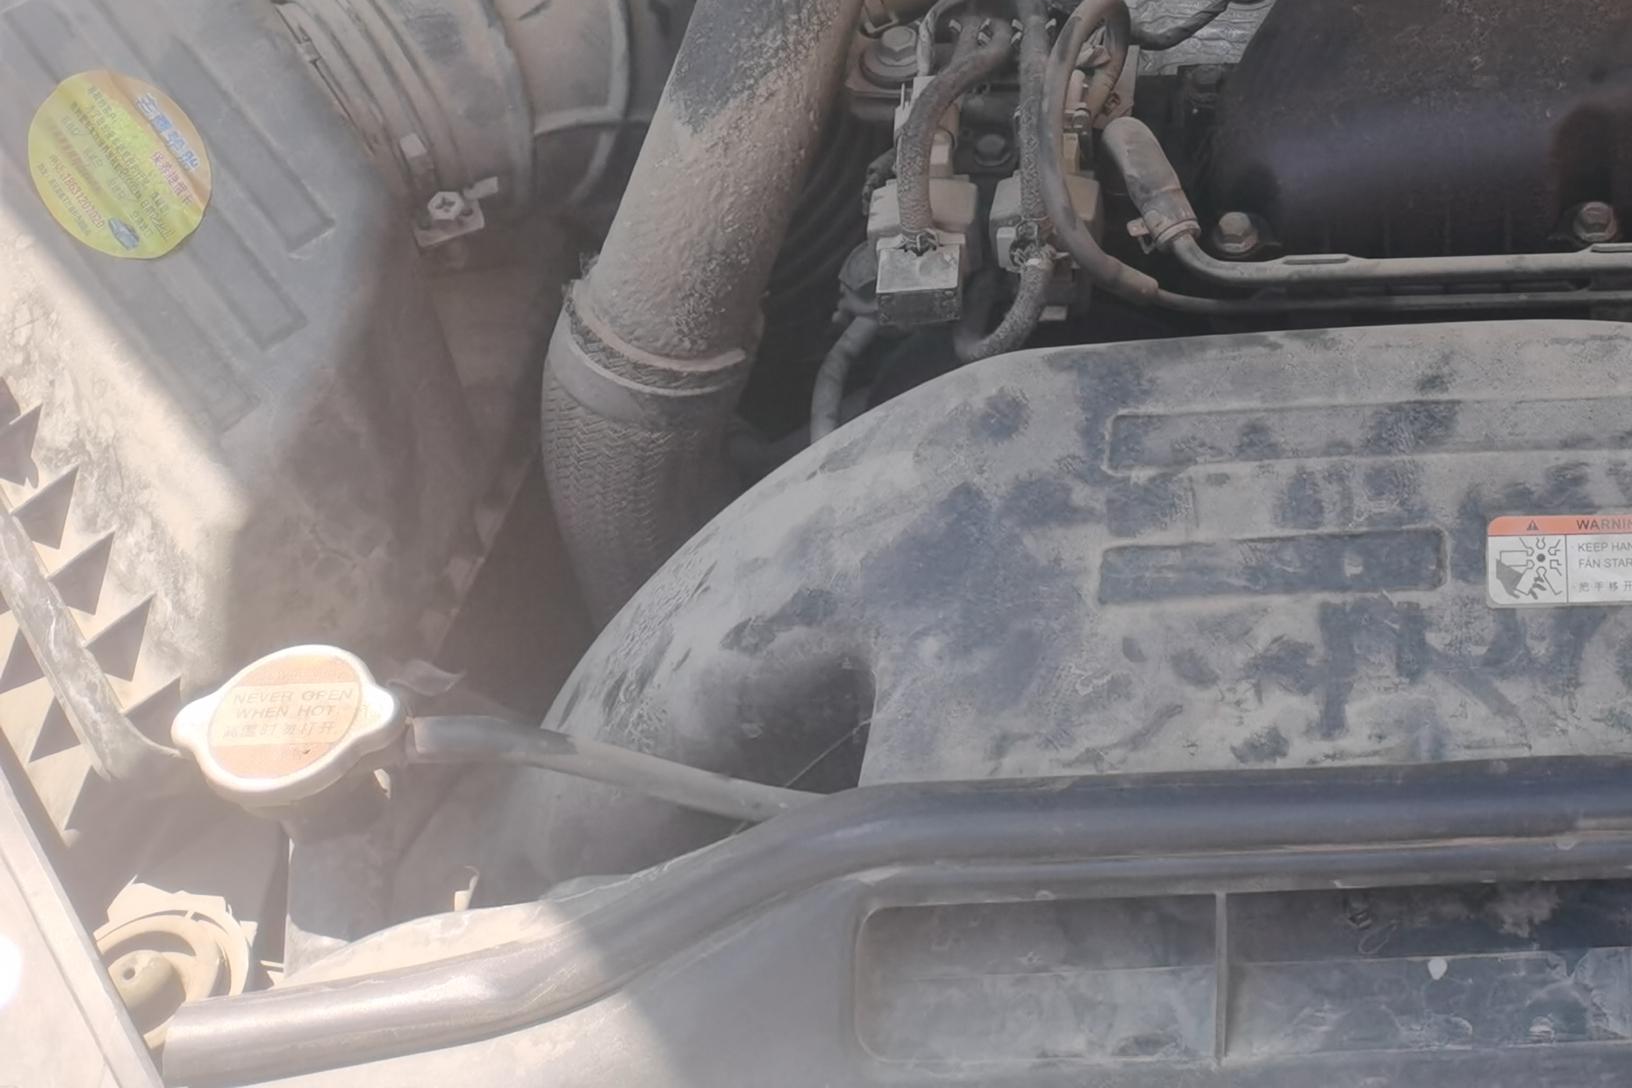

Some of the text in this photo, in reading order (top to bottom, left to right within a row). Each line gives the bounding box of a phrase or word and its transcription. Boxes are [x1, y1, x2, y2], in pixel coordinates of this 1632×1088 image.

[1577, 542, 1609, 553] KEEP
[1578, 558, 1600, 569] FAN
[232, 687, 354, 705] NEVER OPEN
[236, 705, 289, 719] WHEN
